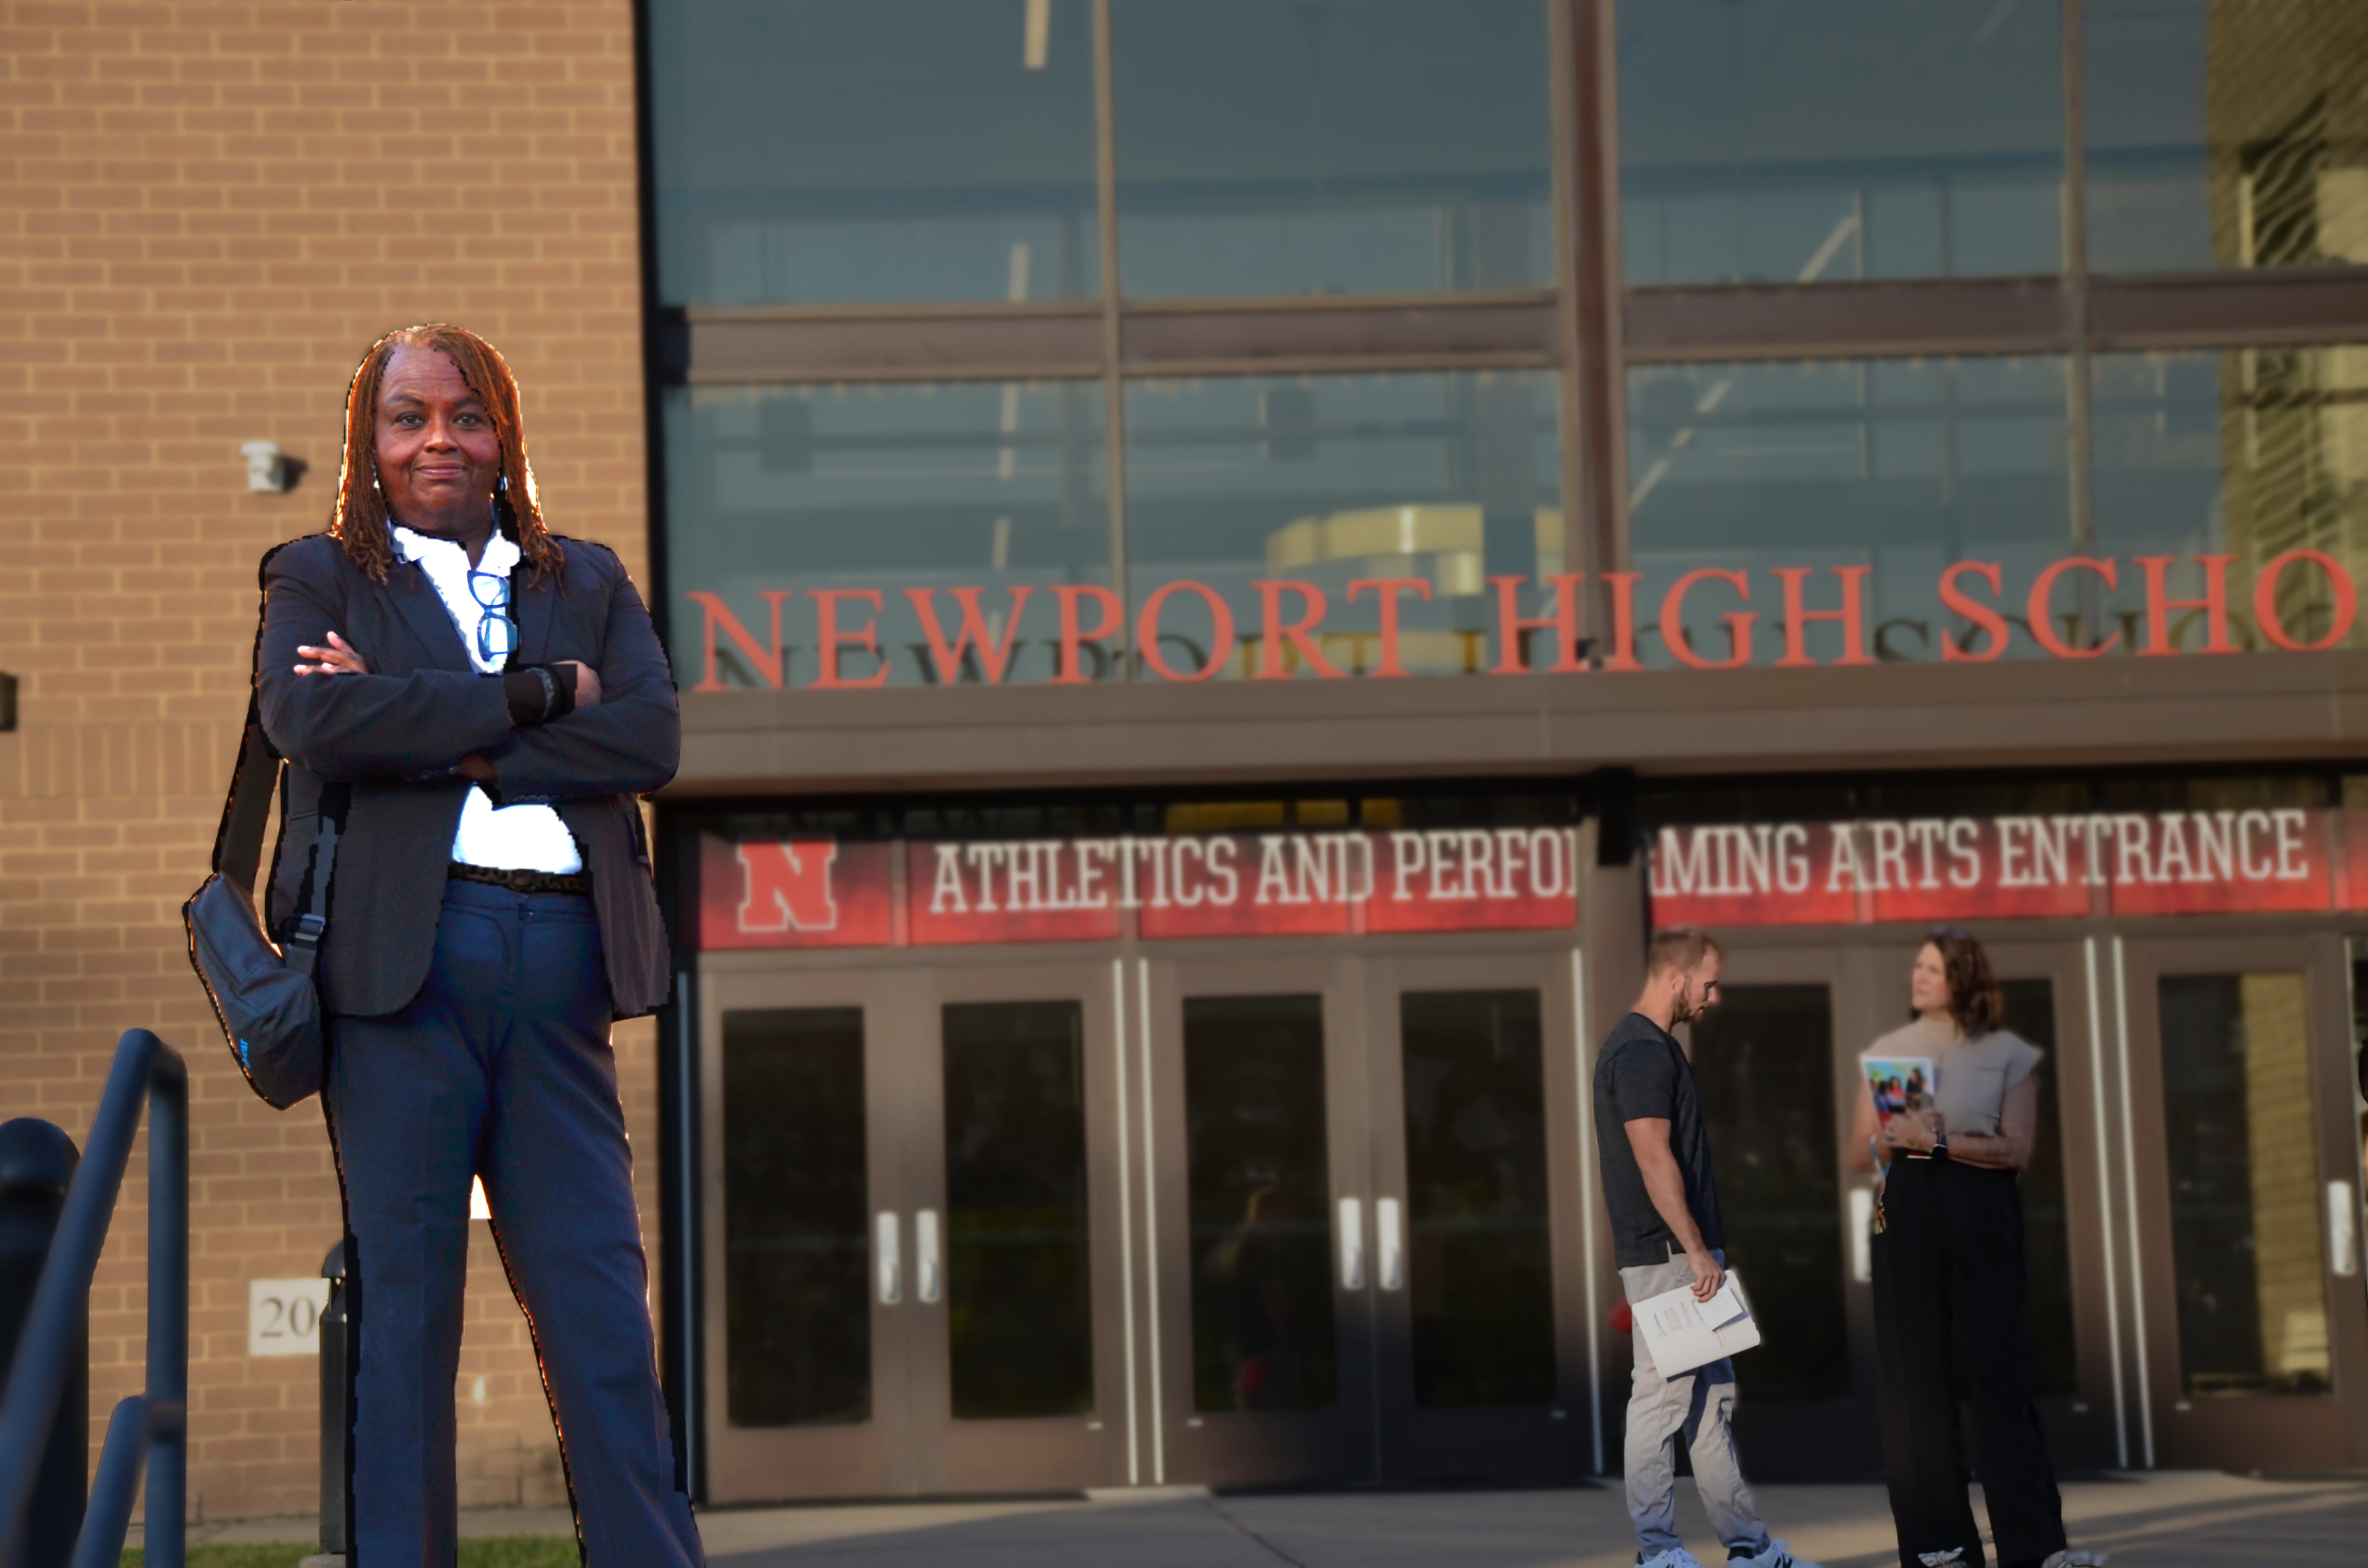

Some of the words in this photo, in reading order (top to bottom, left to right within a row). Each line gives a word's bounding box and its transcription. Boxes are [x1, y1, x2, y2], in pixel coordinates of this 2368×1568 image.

[686, 578, 1431, 692] NEWPORT
[1486, 565, 1875, 674] HIGH
[1938, 549, 2357, 663] SCHO
[737, 839, 836, 931] N
[930, 835, 1239, 913] ATHLETICS
[1254, 832, 1374, 904] AND
[1391, 823, 1809, 900] PERFOMING
[1825, 819, 1981, 892] ARTS
[1994, 810, 2308, 887] ENTRANCE
